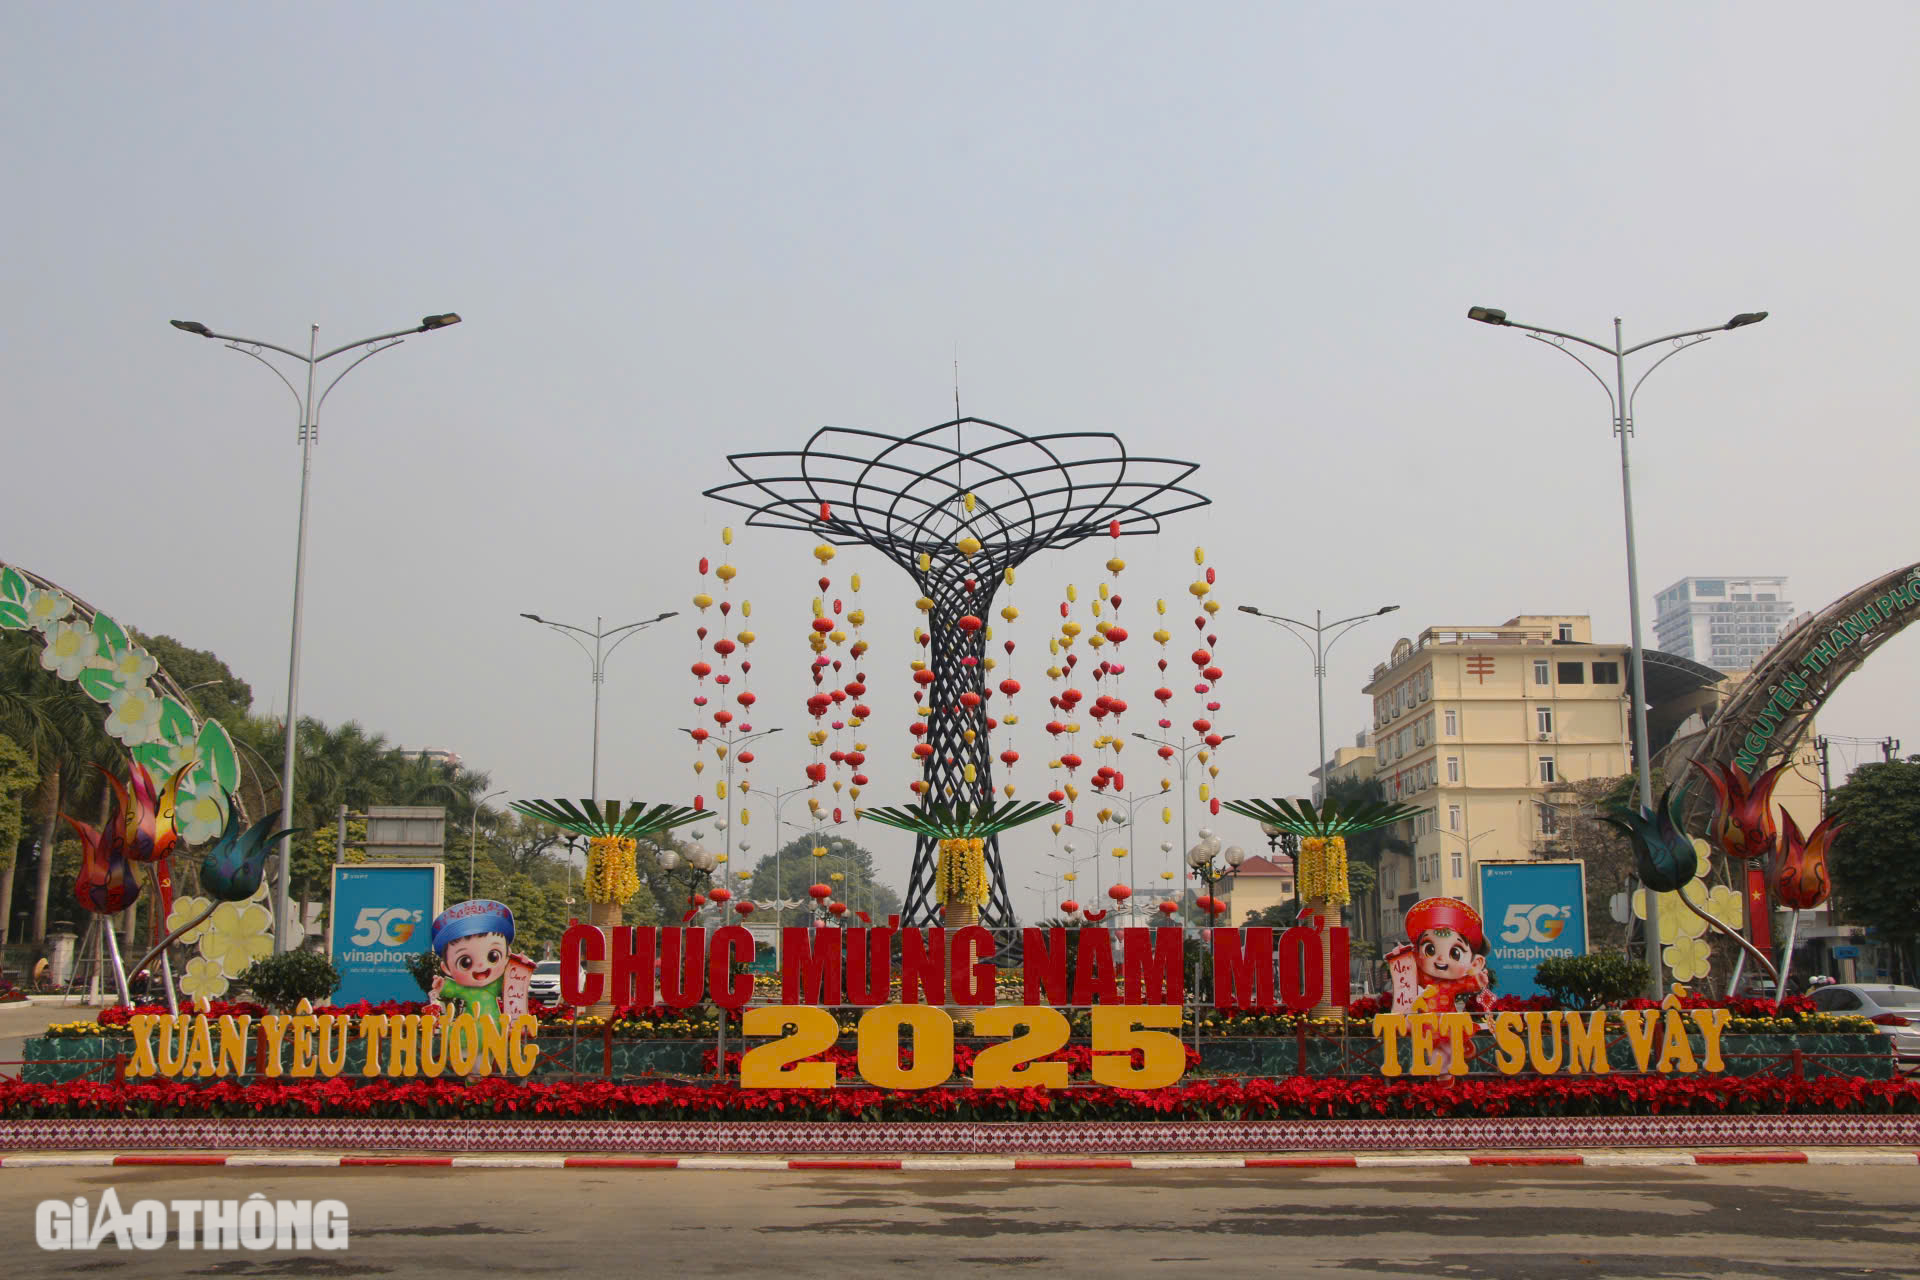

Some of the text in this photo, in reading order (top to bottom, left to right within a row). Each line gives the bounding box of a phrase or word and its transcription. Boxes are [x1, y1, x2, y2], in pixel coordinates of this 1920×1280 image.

[560, 909, 756, 1008] CHÚC
[782, 911, 996, 1006] MỪNG
[1023, 909, 1184, 1007] NĂM
[1213, 908, 1350, 1010] MỚI
[1494, 946, 1574, 960] vinaphone
[125, 997, 540, 1078] XUÂN YÊU THƯƠNG
[740, 1004, 1186, 1090] 2025
[1372, 984, 1473, 1077] TẾT
[1494, 1010, 1610, 1076] SUM
